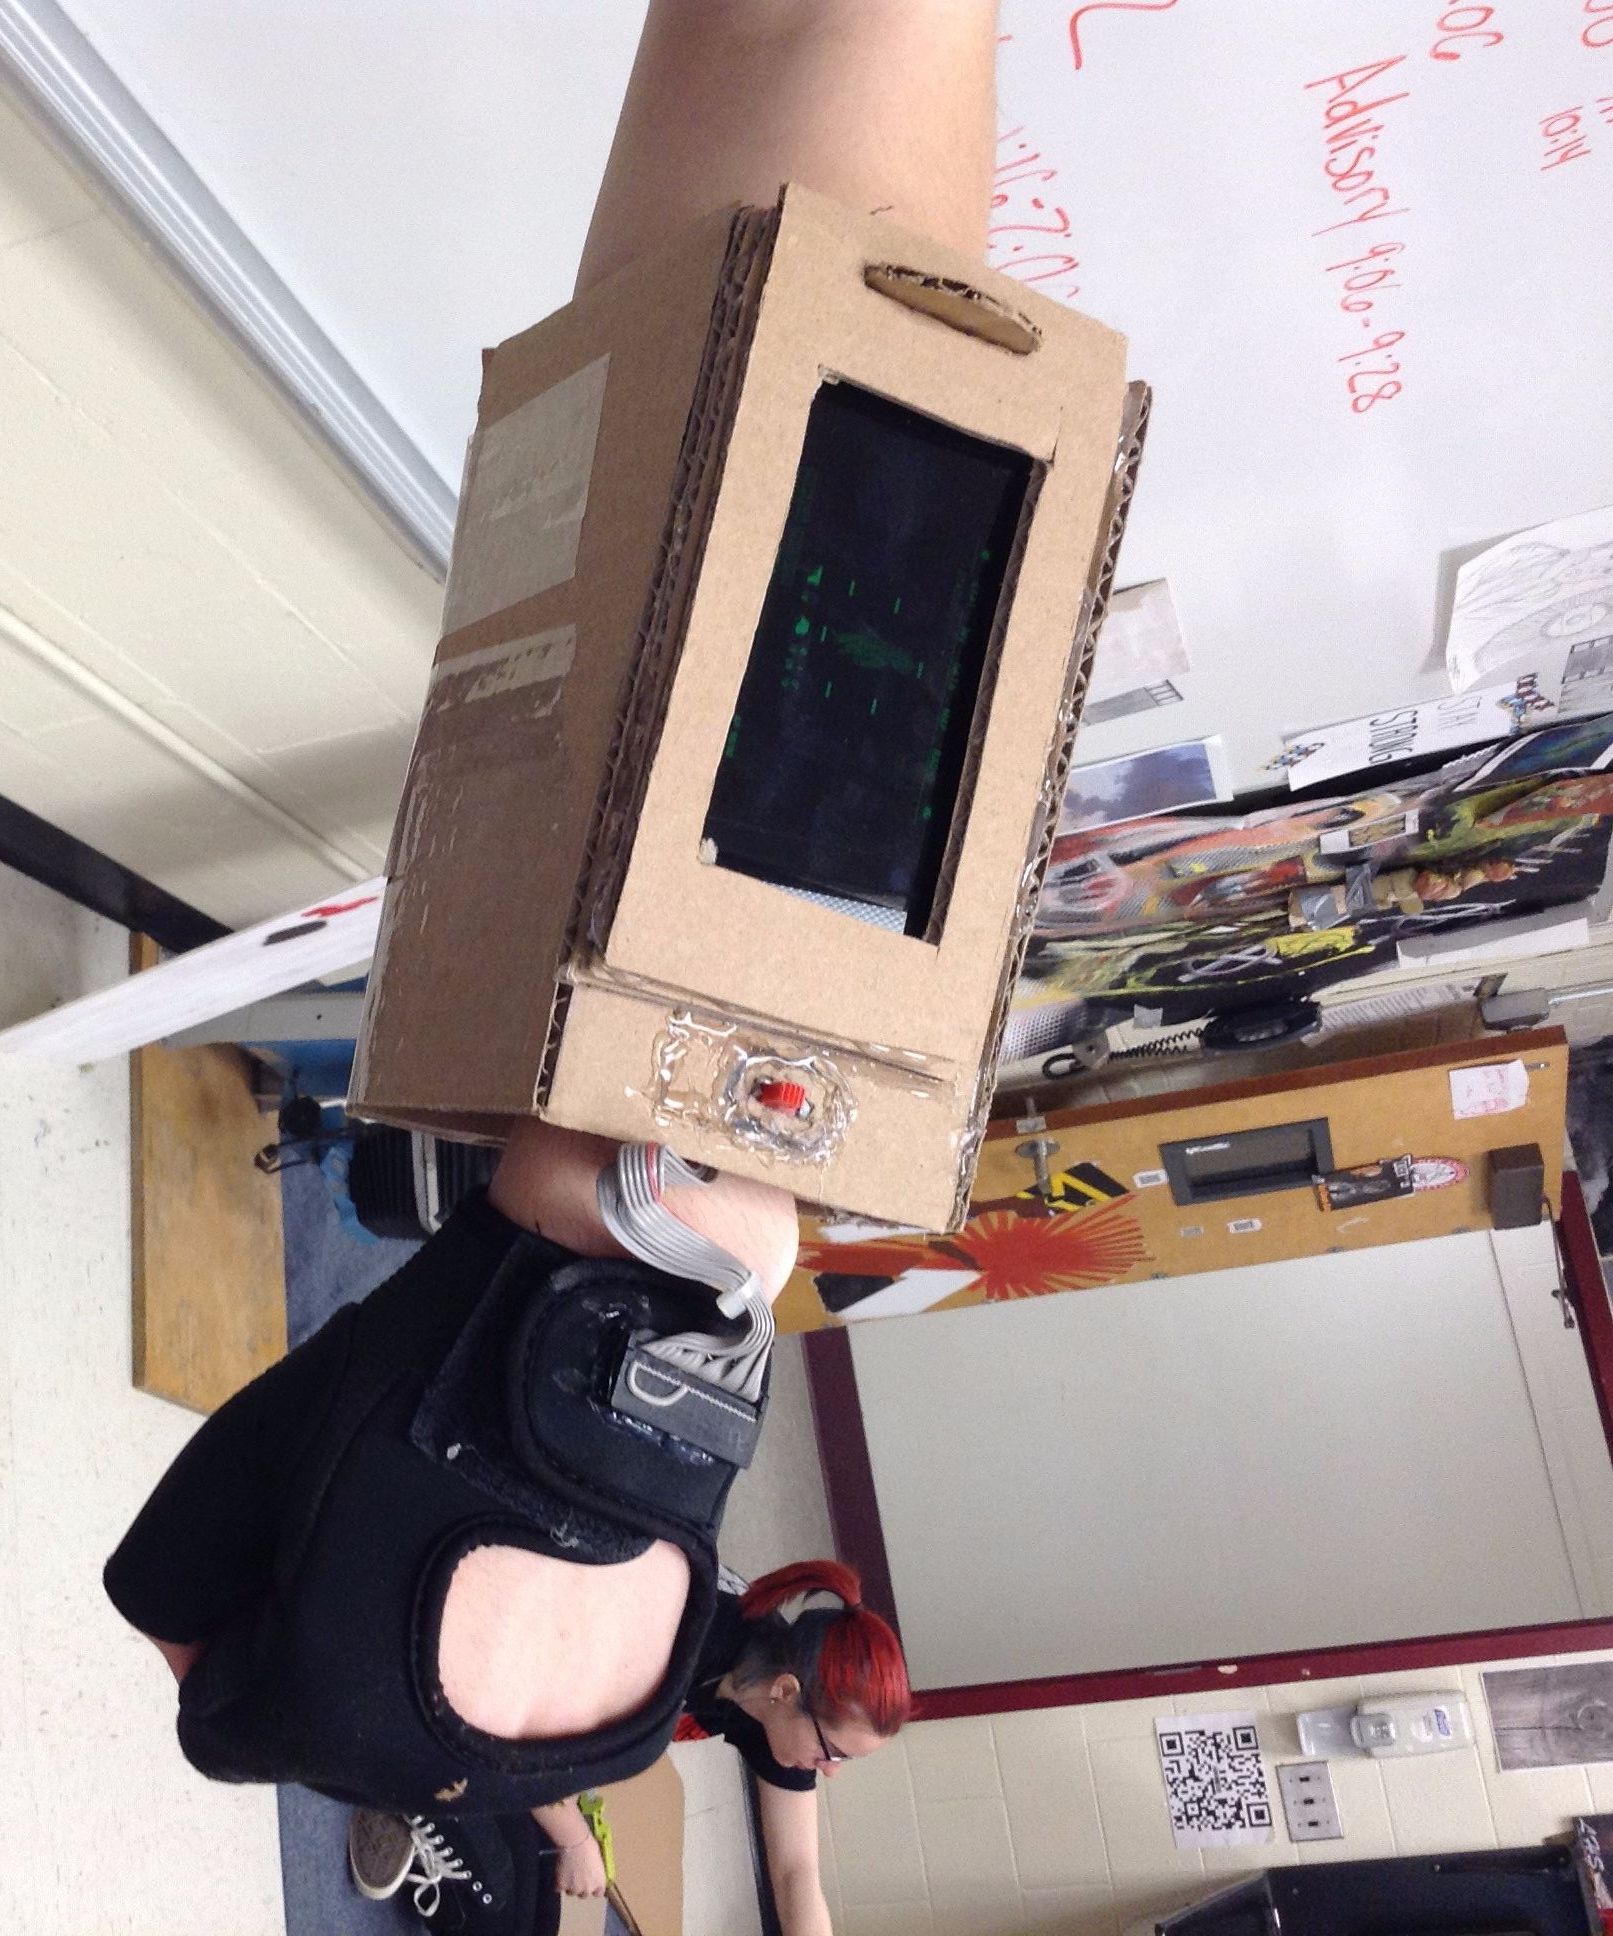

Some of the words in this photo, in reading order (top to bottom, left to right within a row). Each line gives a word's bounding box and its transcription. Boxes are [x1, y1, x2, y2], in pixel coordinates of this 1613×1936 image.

[1304, 54, 1411, 237] Advisory
[1325, 242, 1406, 413] 9:06-9:28
[1368, 709, 1419, 766] STRONG
